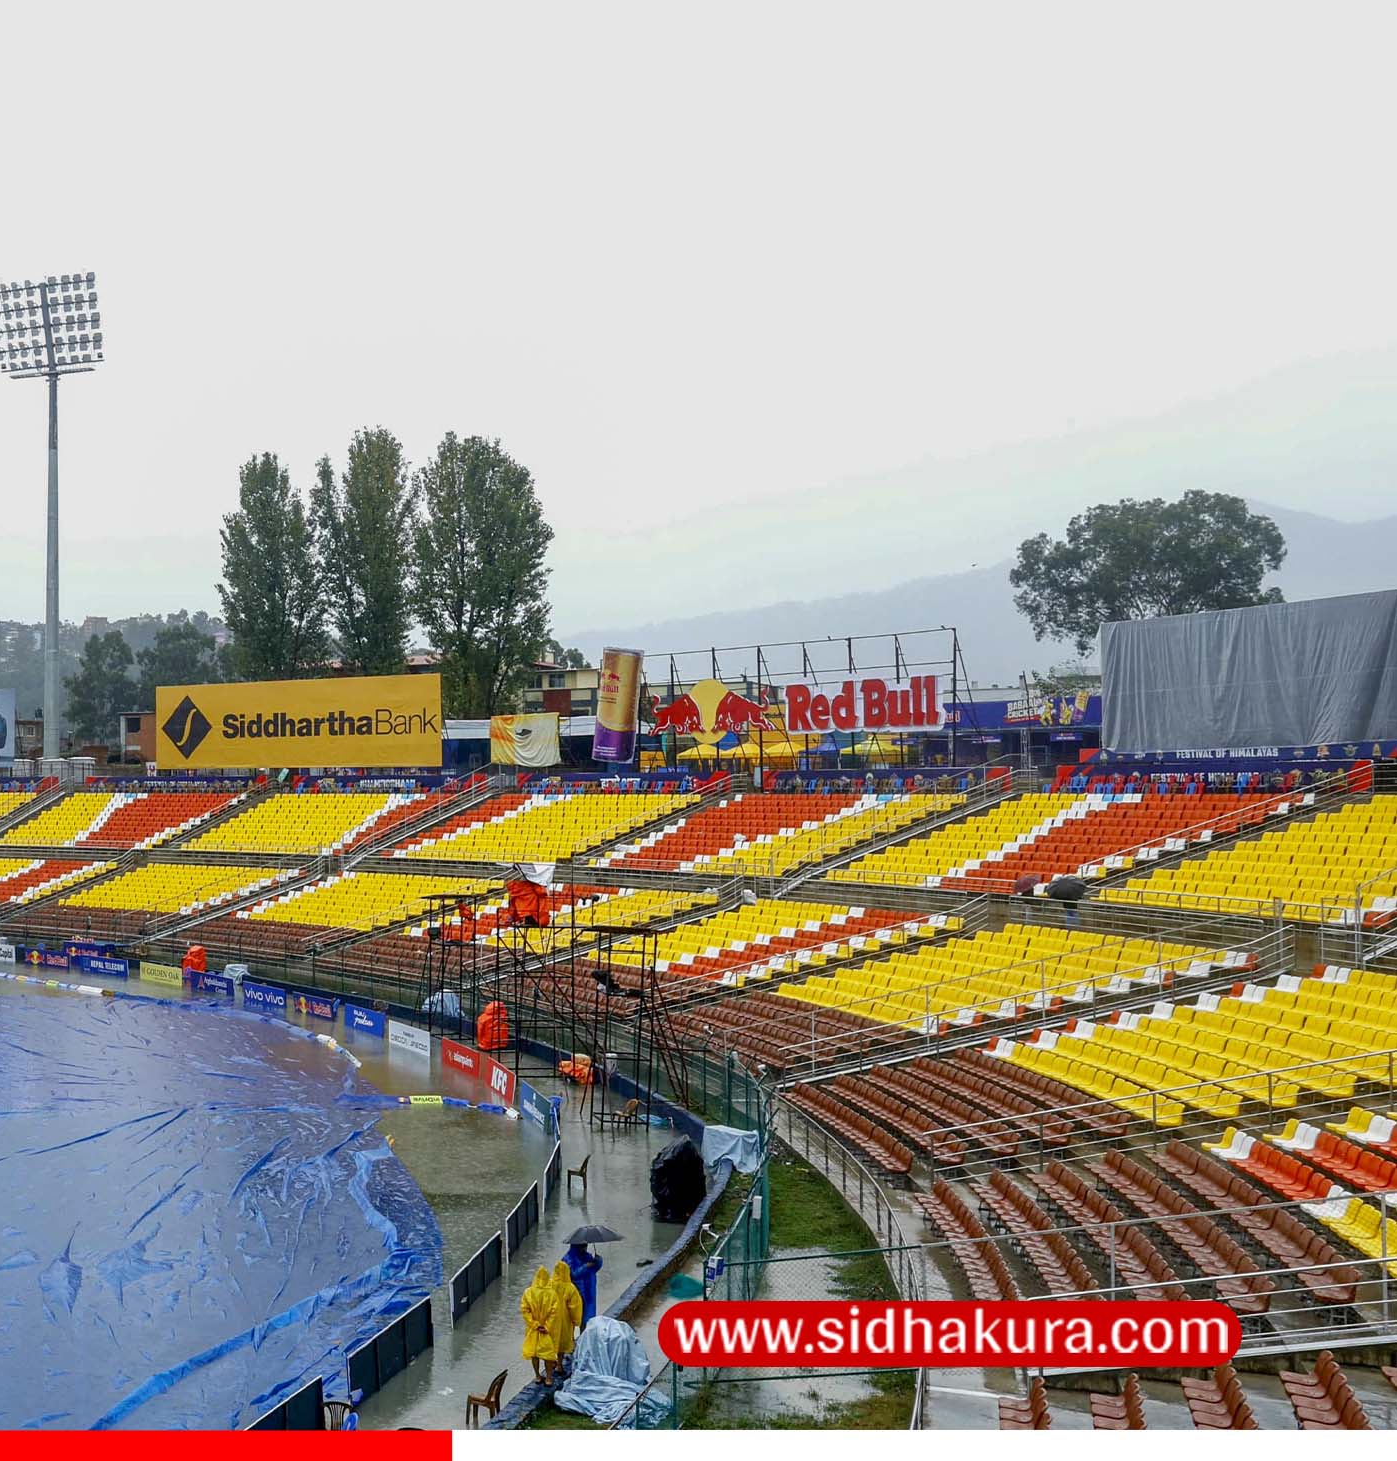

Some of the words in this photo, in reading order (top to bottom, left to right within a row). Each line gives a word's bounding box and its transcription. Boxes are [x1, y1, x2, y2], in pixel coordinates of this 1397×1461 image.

[785, 680, 858, 732] Red
[860, 675, 939, 728] Bull
[1176, 749, 1214, 759] FESTIVAL
[1216, 749, 1227, 758] OF
[1229, 747, 1279, 758] HIMALAYAS
[245, 987, 264, 1001] vivo
[264, 991, 284, 1006] vivo
[491, 1065, 508, 1095] KFC
